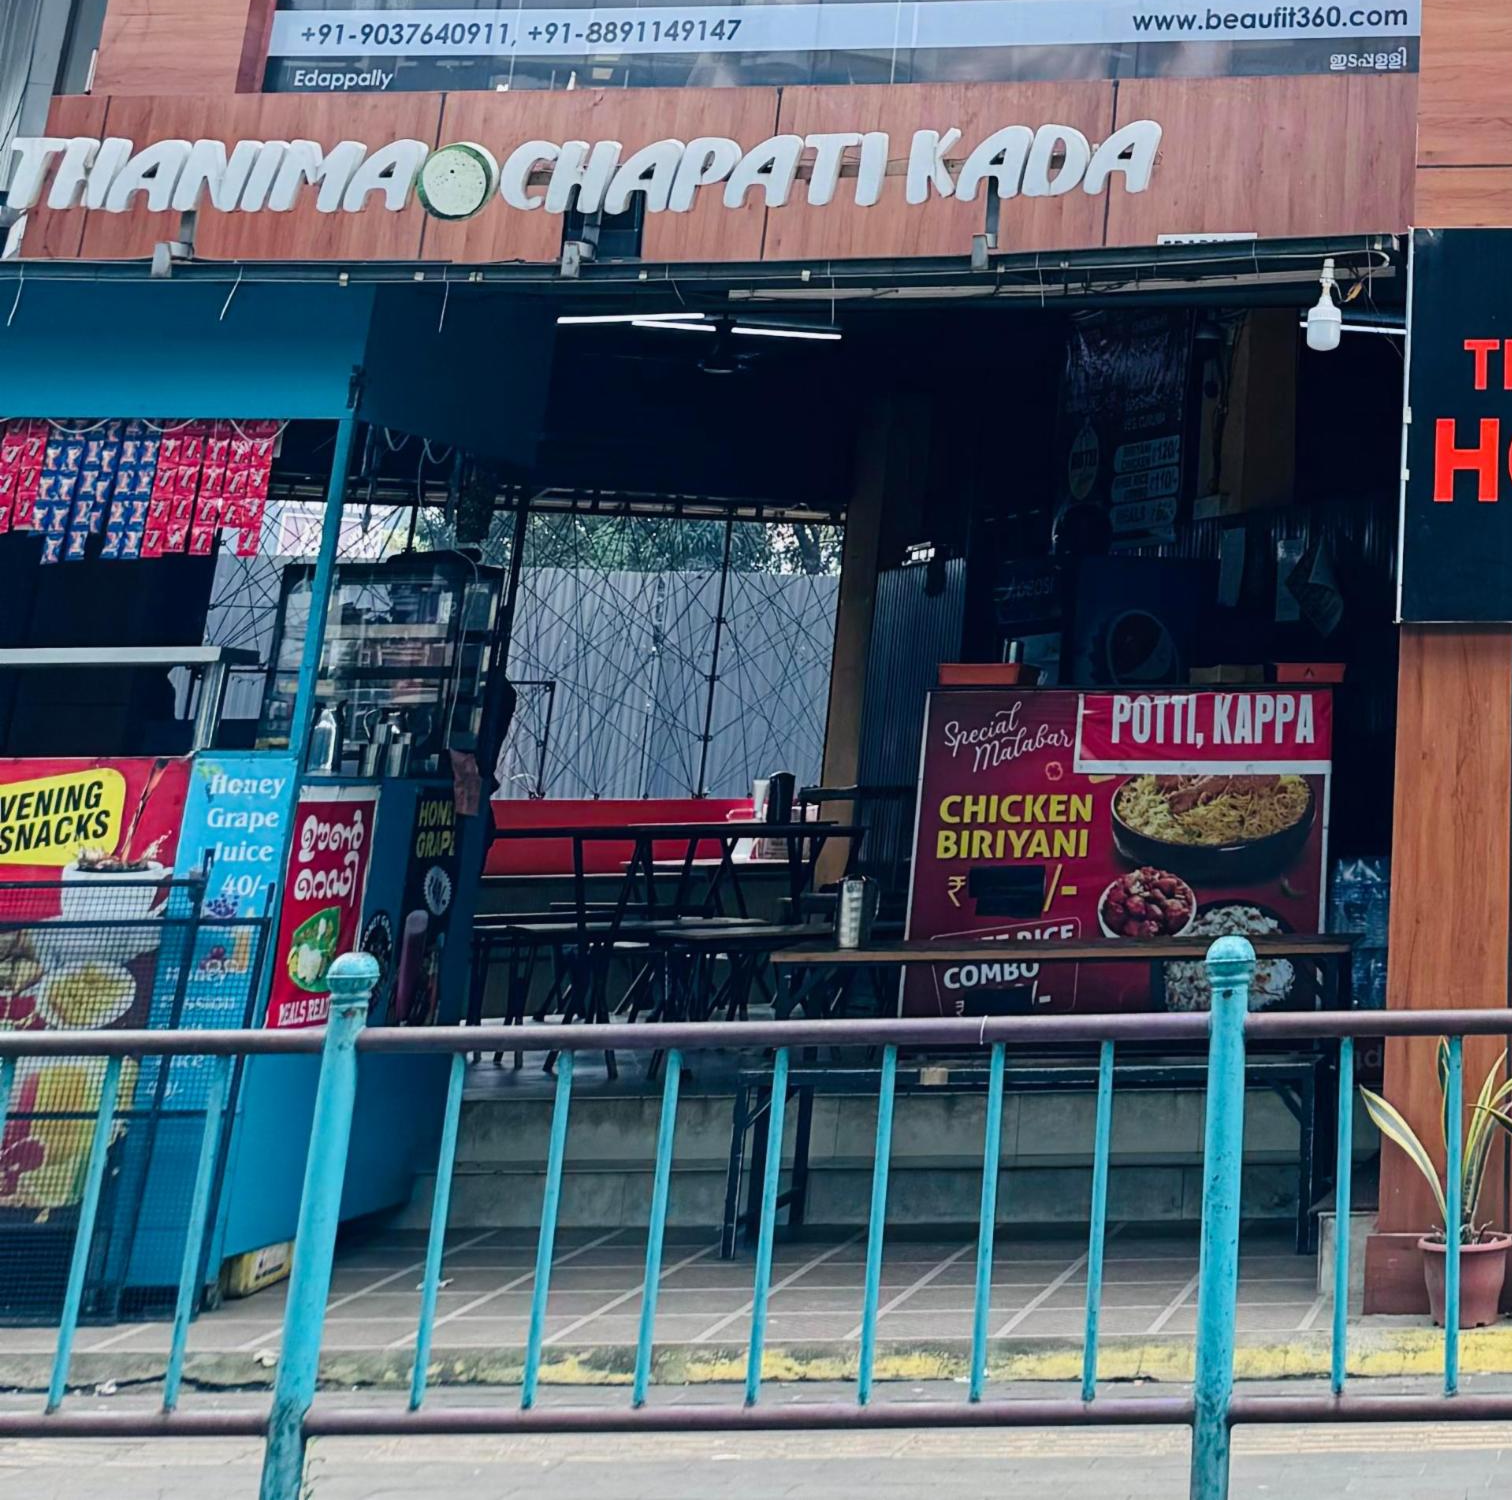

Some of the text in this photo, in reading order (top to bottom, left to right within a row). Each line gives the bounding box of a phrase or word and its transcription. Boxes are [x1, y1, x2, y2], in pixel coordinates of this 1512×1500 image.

[300, 18, 742, 48] +91-9037640911, +91-8891149147
[1132, 5, 1408, 33] www.beaufit360.com
[293, 67, 394, 90] Edappally
[6, 119, 1163, 214] THANIMA CHAPATI KADA
[1111, 693, 1316, 749] POTTI, KAPPA
[944, 701, 1074, 774] Special Malabar
[210, 774, 286, 799] Honey
[0, 780, 103, 824] VENING
[939, 794, 1093, 824] CHICKEN
[0, 809, 111, 855] SNACKS
[207, 808, 280, 833] Grape
[212, 842, 274, 863] Juice
[935, 829, 1089, 860] BIRIYANI
[222, 873, 268, 897] 40/-
